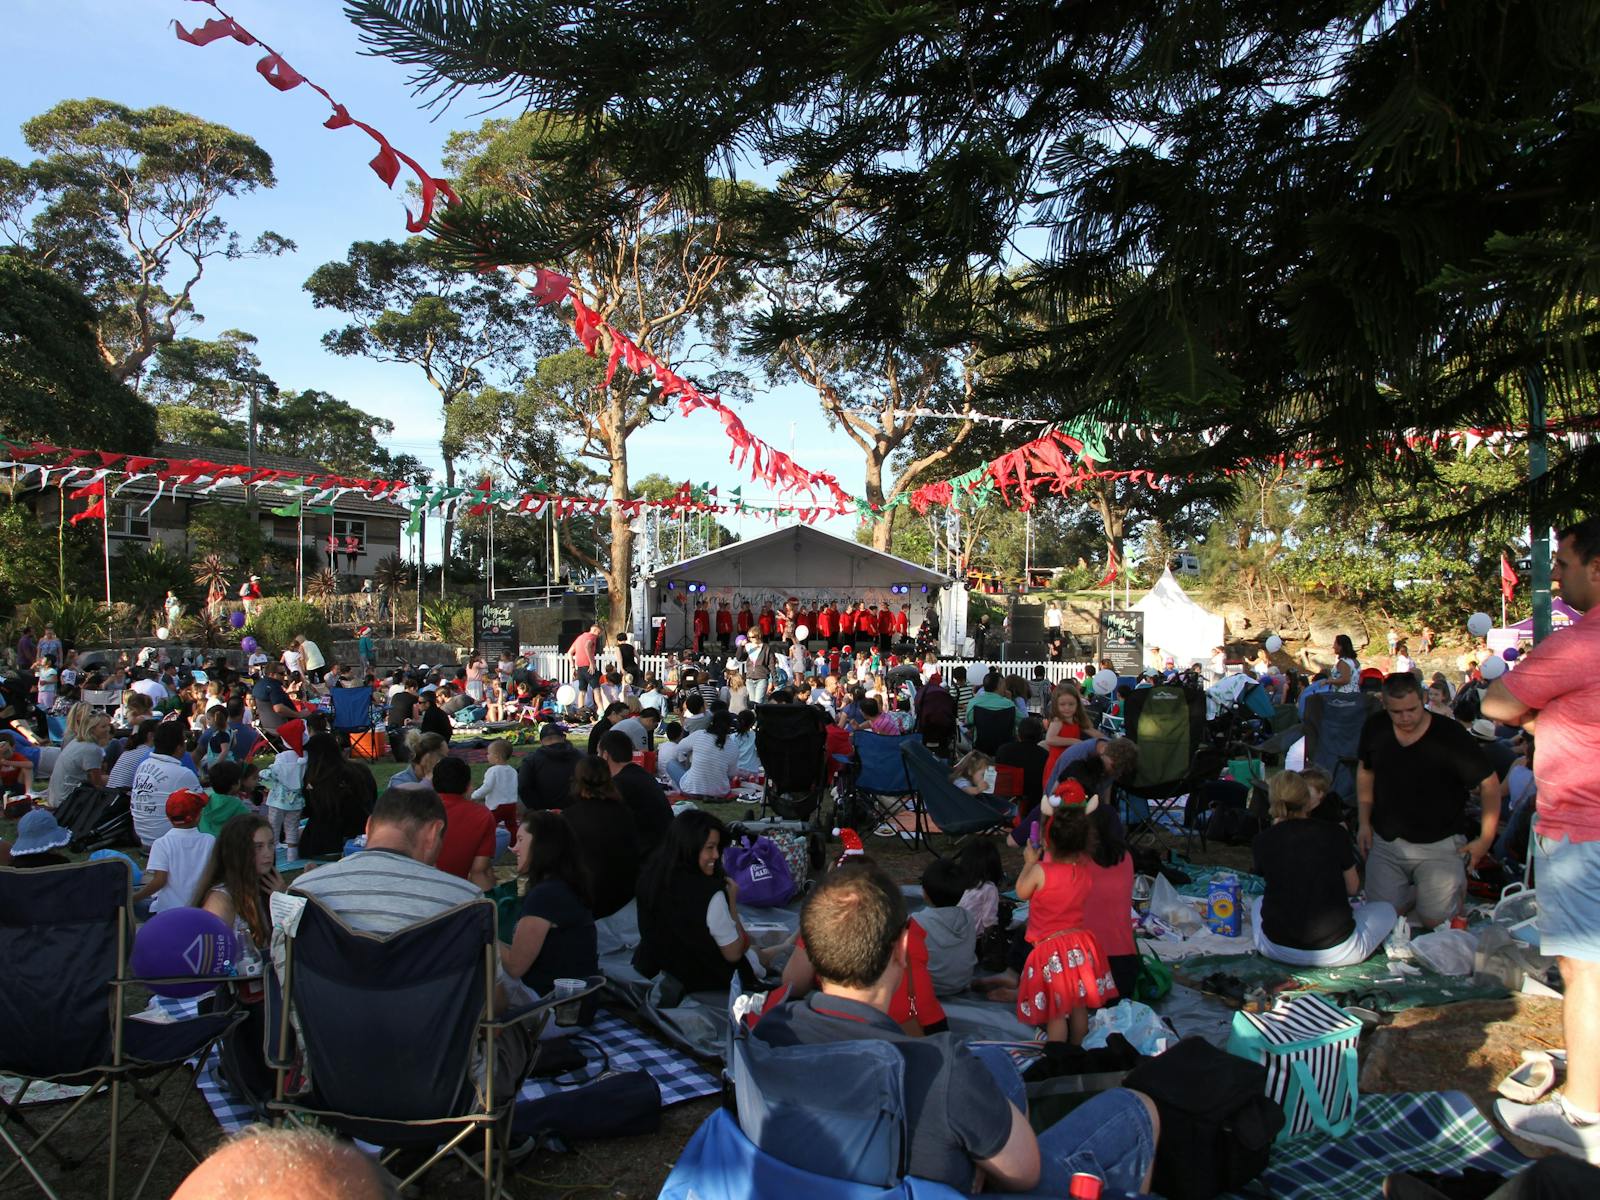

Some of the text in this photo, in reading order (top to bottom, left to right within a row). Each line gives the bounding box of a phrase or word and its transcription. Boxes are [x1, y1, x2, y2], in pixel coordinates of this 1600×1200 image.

[482, 604, 504, 619] Magic
[1107, 614, 1137, 630] Magic of
[213, 934, 225, 974] Aussie
